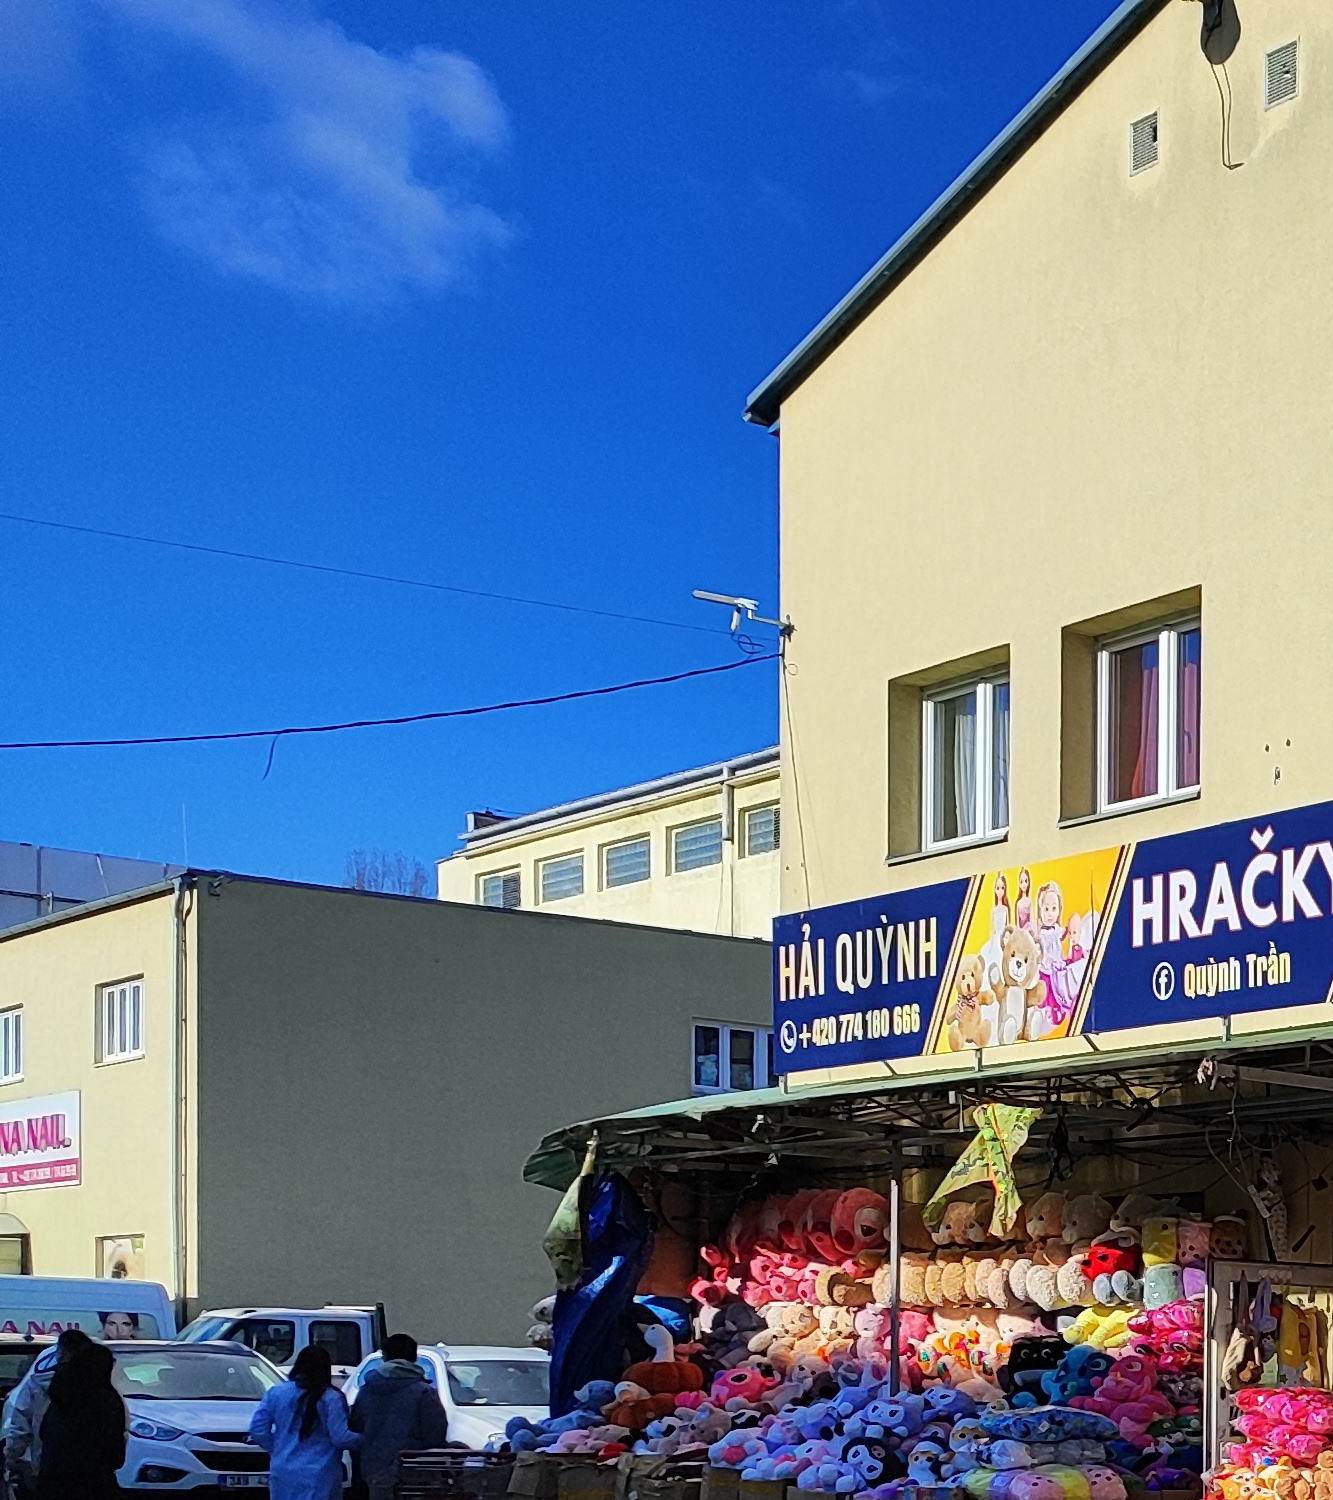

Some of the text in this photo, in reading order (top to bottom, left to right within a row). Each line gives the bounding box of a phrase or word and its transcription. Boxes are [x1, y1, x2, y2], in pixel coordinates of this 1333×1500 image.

[778, 914, 937, 1002] HẢI QUỲNH
[1183, 957, 1241, 999] Quỳnh
[1246, 941, 1291, 988] Trần
[799, 1003, 920, 1048] +420 774 180 666
